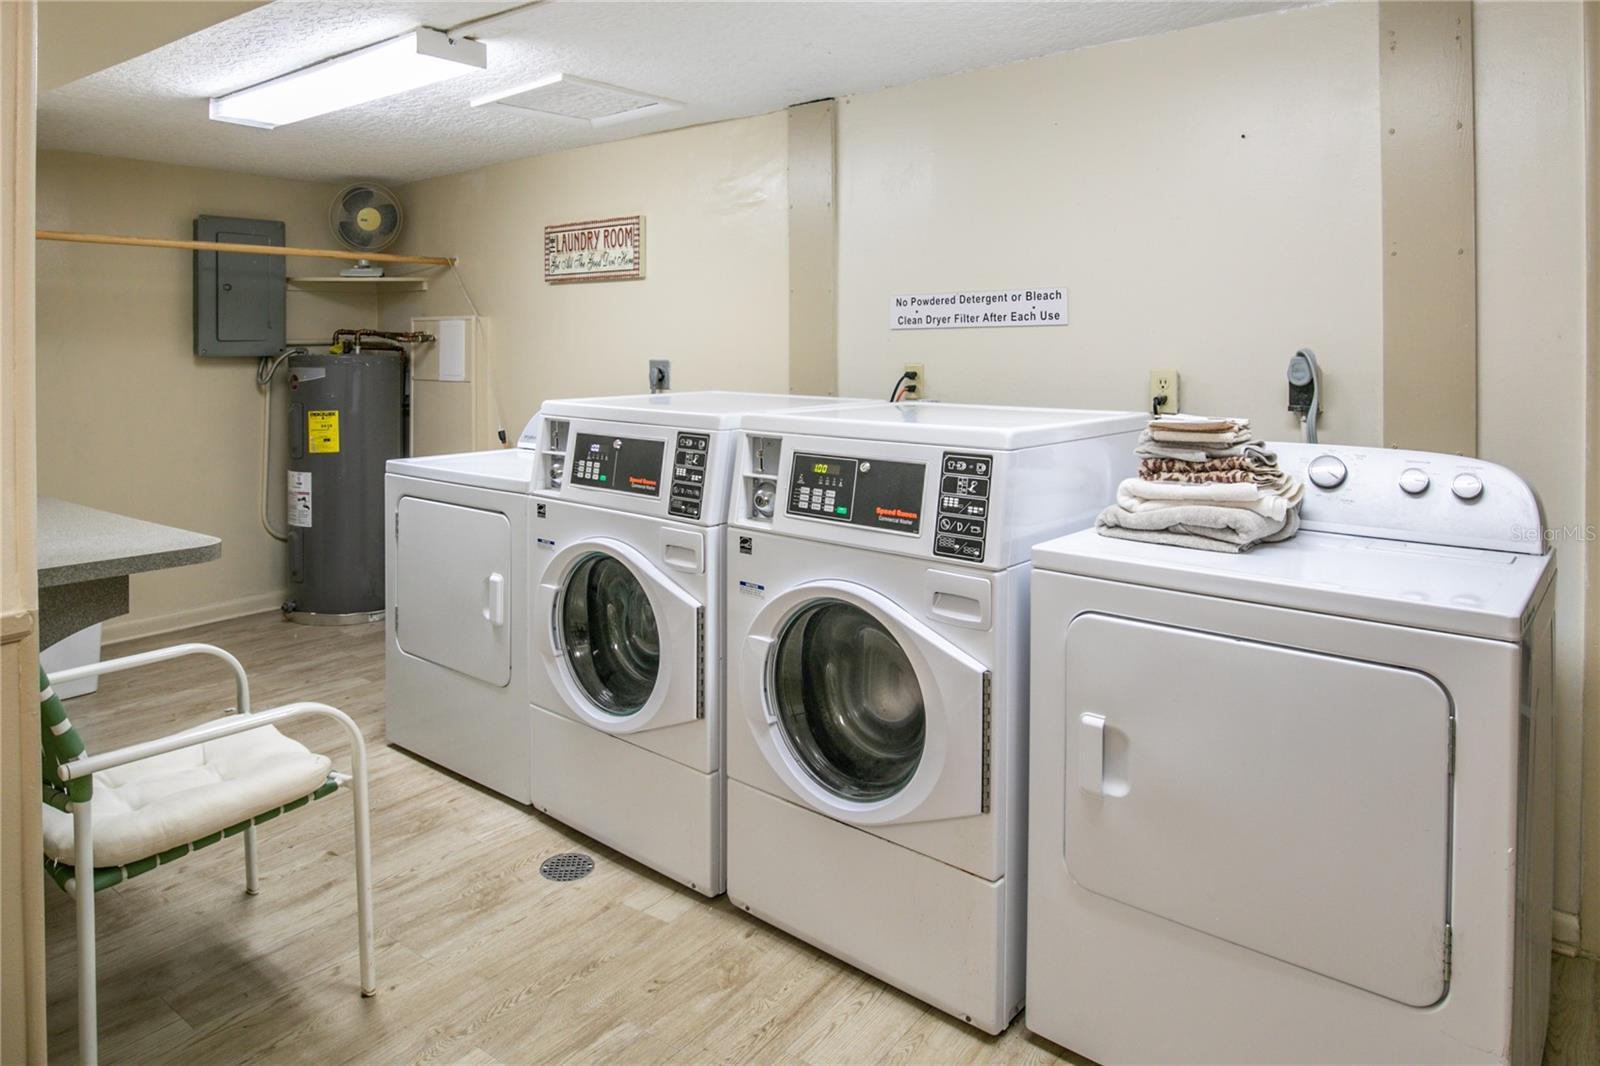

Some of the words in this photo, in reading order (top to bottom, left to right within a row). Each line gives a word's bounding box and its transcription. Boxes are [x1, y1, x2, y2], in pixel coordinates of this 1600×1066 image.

[556, 230, 600, 253] LAUNDRY
[603, 227, 633, 248] ROOM
[896, 298, 908, 307] No
[910, 295, 956, 307] Powdered
[959, 293, 1008, 306] Detergent
[1011, 294, 1022, 302] or
[1025, 290, 1062, 302] Bleach
[897, 315, 923, 326] Clean
[925, 314, 951, 327] Dryer
[954, 312, 980, 324] Filter
[982, 311, 1007, 323] After
[1010, 310, 1036, 323] Each
[1040, 310, 1061, 321] Use
[814, 463, 828, 474] 100
[876, 507, 896, 516] Speed
[896, 509, 917, 519] Queen
